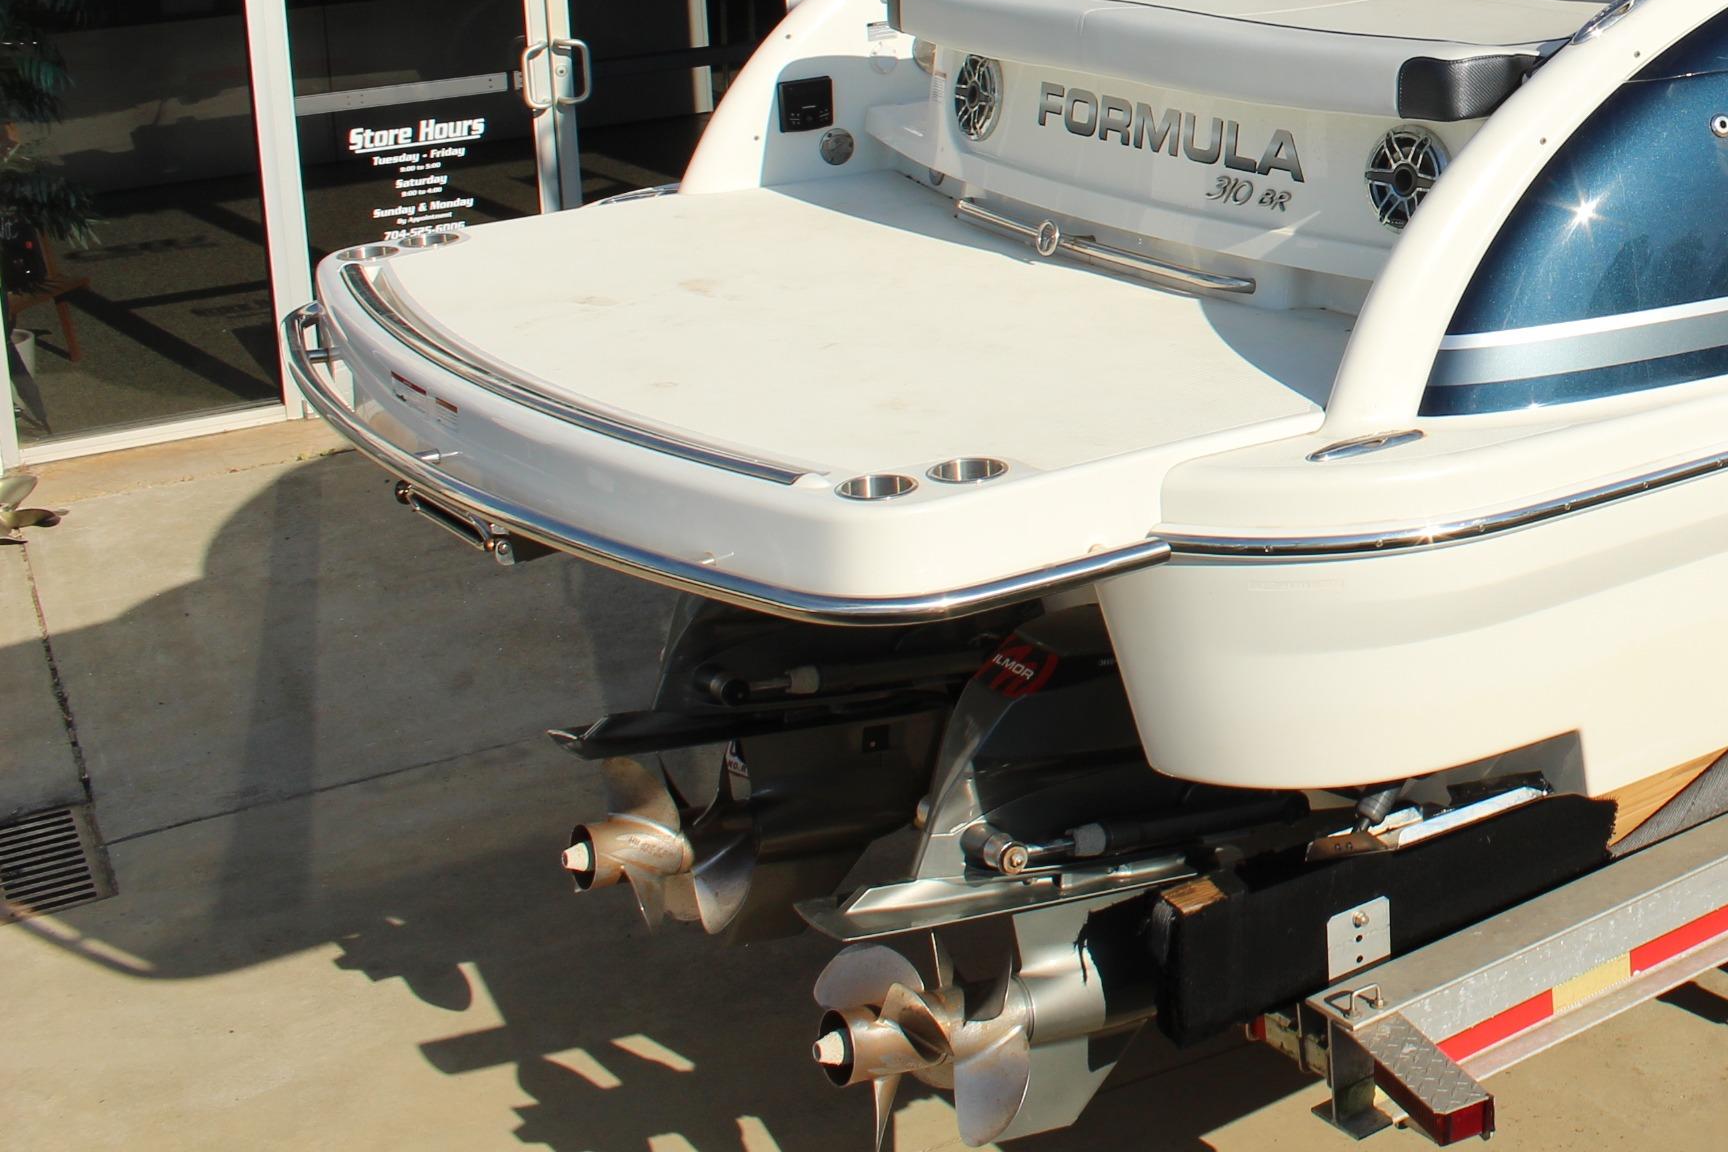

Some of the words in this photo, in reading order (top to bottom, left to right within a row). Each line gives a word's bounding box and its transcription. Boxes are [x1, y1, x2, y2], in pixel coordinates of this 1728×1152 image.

[348, 127, 413, 151] Store
[418, 118, 485, 142] Hours
[1038, 81, 1305, 183] FORMULA
[372, 151, 420, 166] Tuesday
[430, 147, 466, 159] Friday
[395, 174, 448, 189] Saturday
[1205, 175, 1253, 207] 310
[1258, 190, 1292, 212] BR
[373, 205, 416, 218] Sunday
[418, 202, 427, 212] &
[430, 197, 475, 211] Monday
[408, 211, 453, 223] Appointment
[992, 652, 1035, 680] ILMOR
